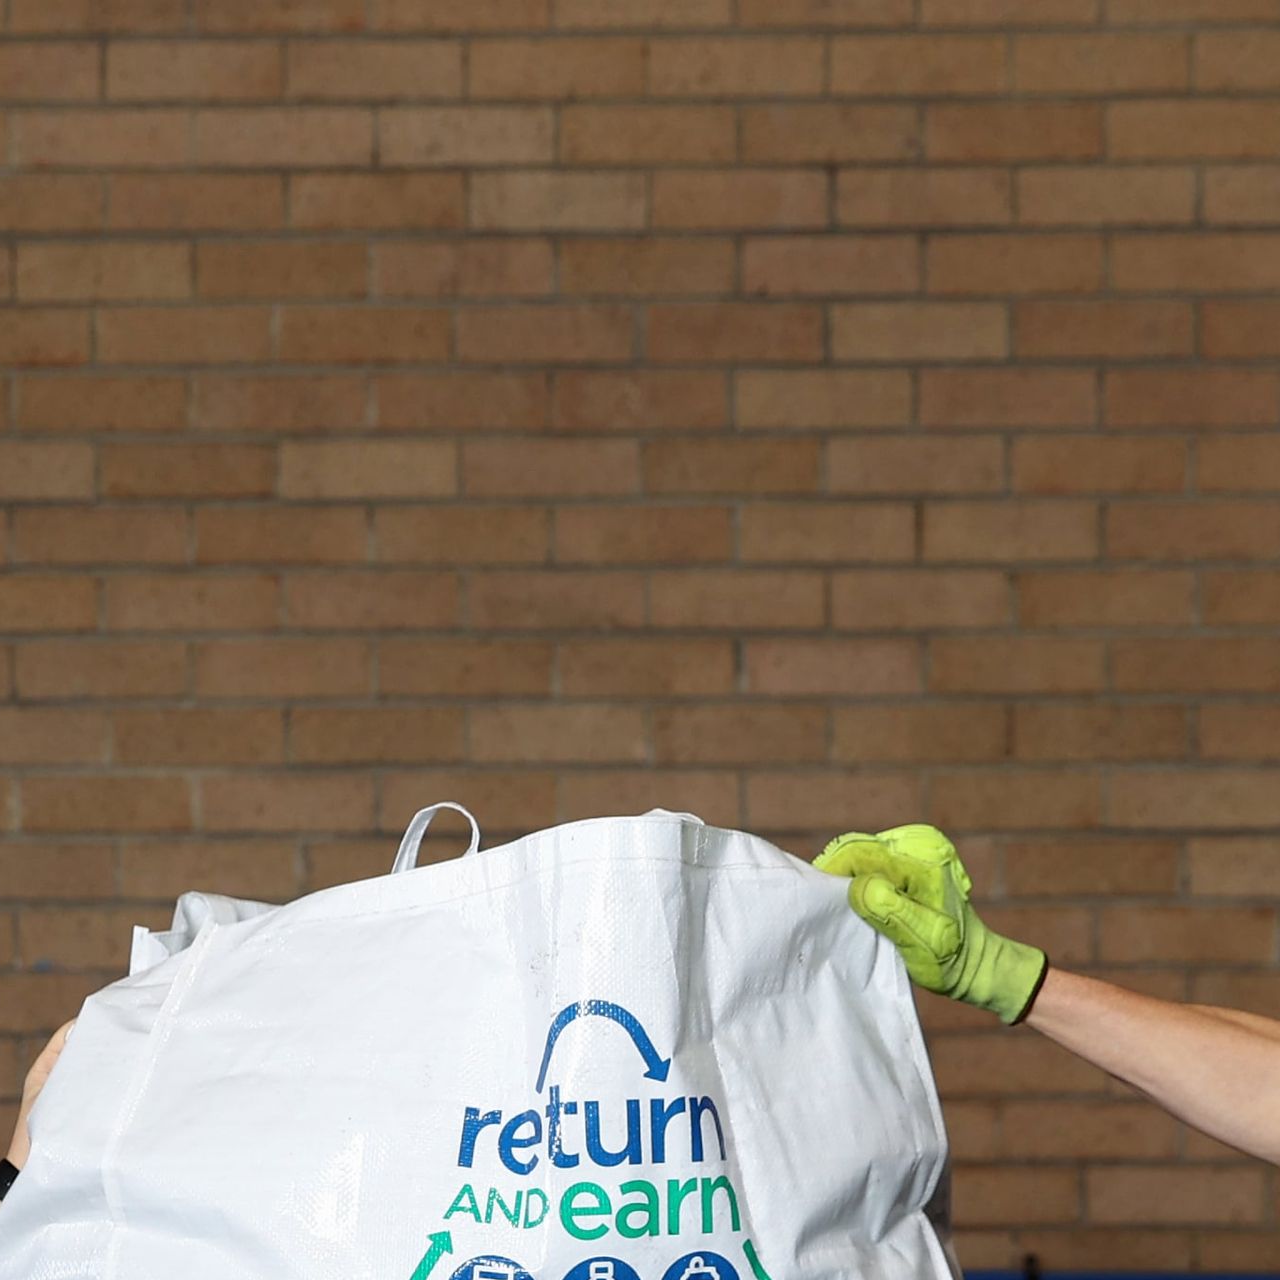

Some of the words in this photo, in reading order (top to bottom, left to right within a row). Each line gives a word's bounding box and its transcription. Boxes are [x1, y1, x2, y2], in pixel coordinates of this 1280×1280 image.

[457, 1085, 727, 1176] return
[443, 1183, 551, 1229] AND
[559, 1173, 742, 1241] earn
